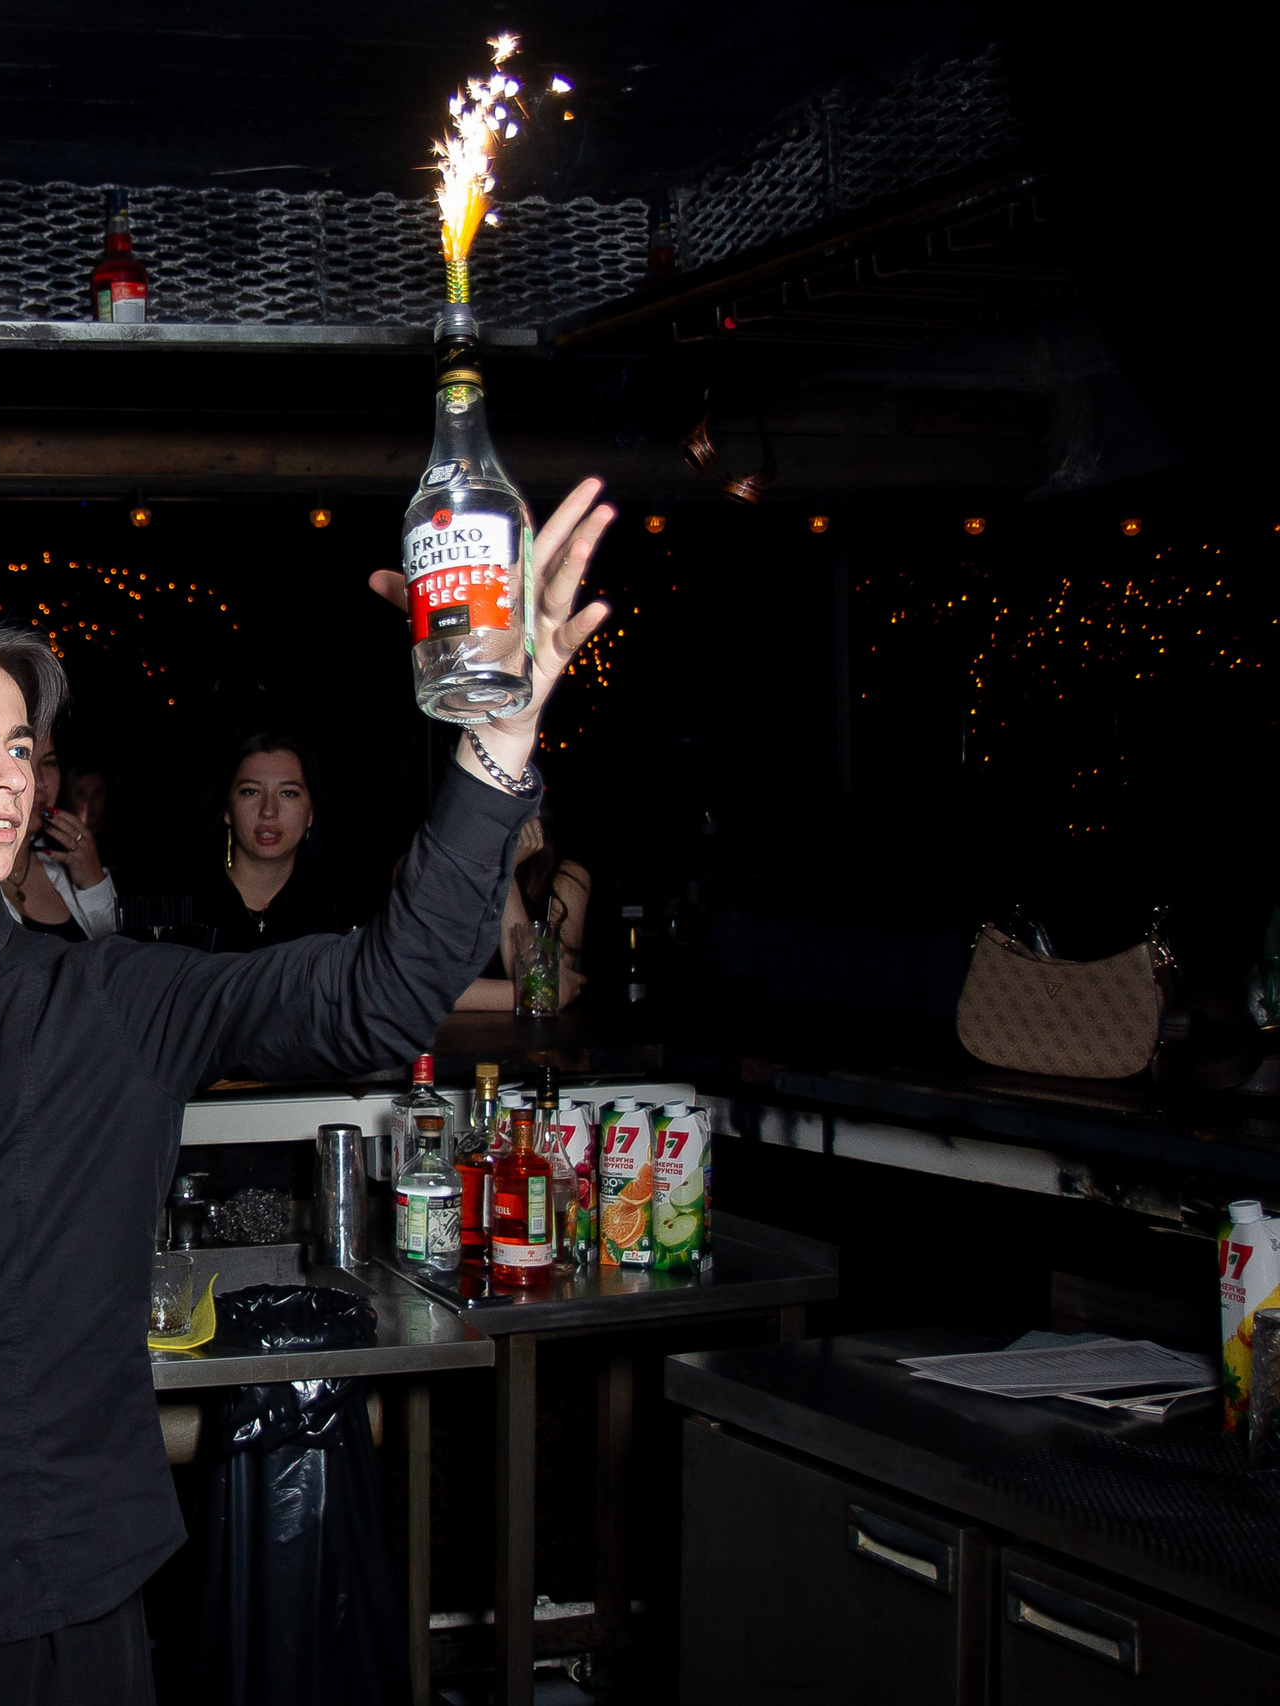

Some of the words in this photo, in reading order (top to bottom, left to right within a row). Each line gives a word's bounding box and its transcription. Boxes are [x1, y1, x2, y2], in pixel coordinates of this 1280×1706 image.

[412, 528, 483, 557] FRUKO
[409, 545, 492, 577] SCHULZ
[417, 570, 482, 597] TRIPLE
[429, 586, 467, 607] SEC
[603, 1126, 640, 1154] J7
[654, 1130, 690, 1159] J7
[1220, 1282, 1247, 1296] НЕРГИЯ
[1220, 1289, 1246, 1304] РУКТОВ
